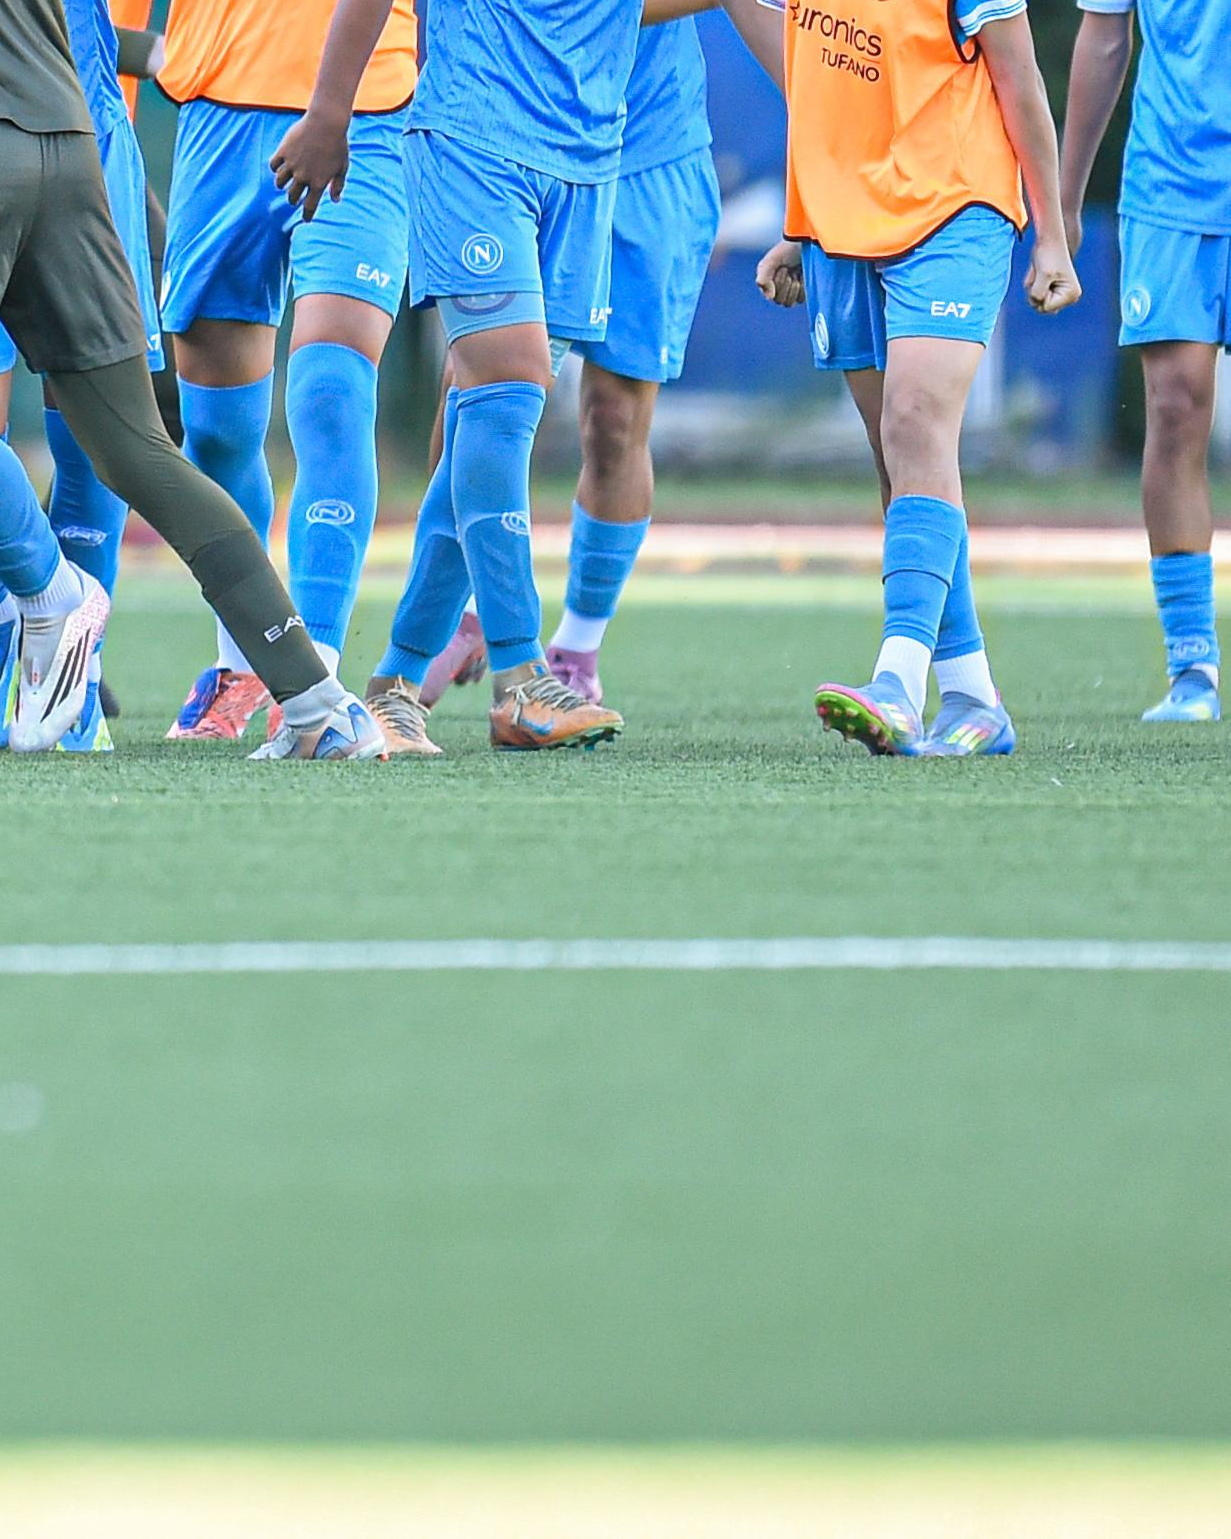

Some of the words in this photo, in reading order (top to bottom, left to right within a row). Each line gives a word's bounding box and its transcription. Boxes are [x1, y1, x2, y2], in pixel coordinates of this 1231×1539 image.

[822, 48, 880, 82] TUFANO
[473, 243, 491, 264] N
[356, 262, 391, 289] EA7
[930, 300, 971, 319] EA7
